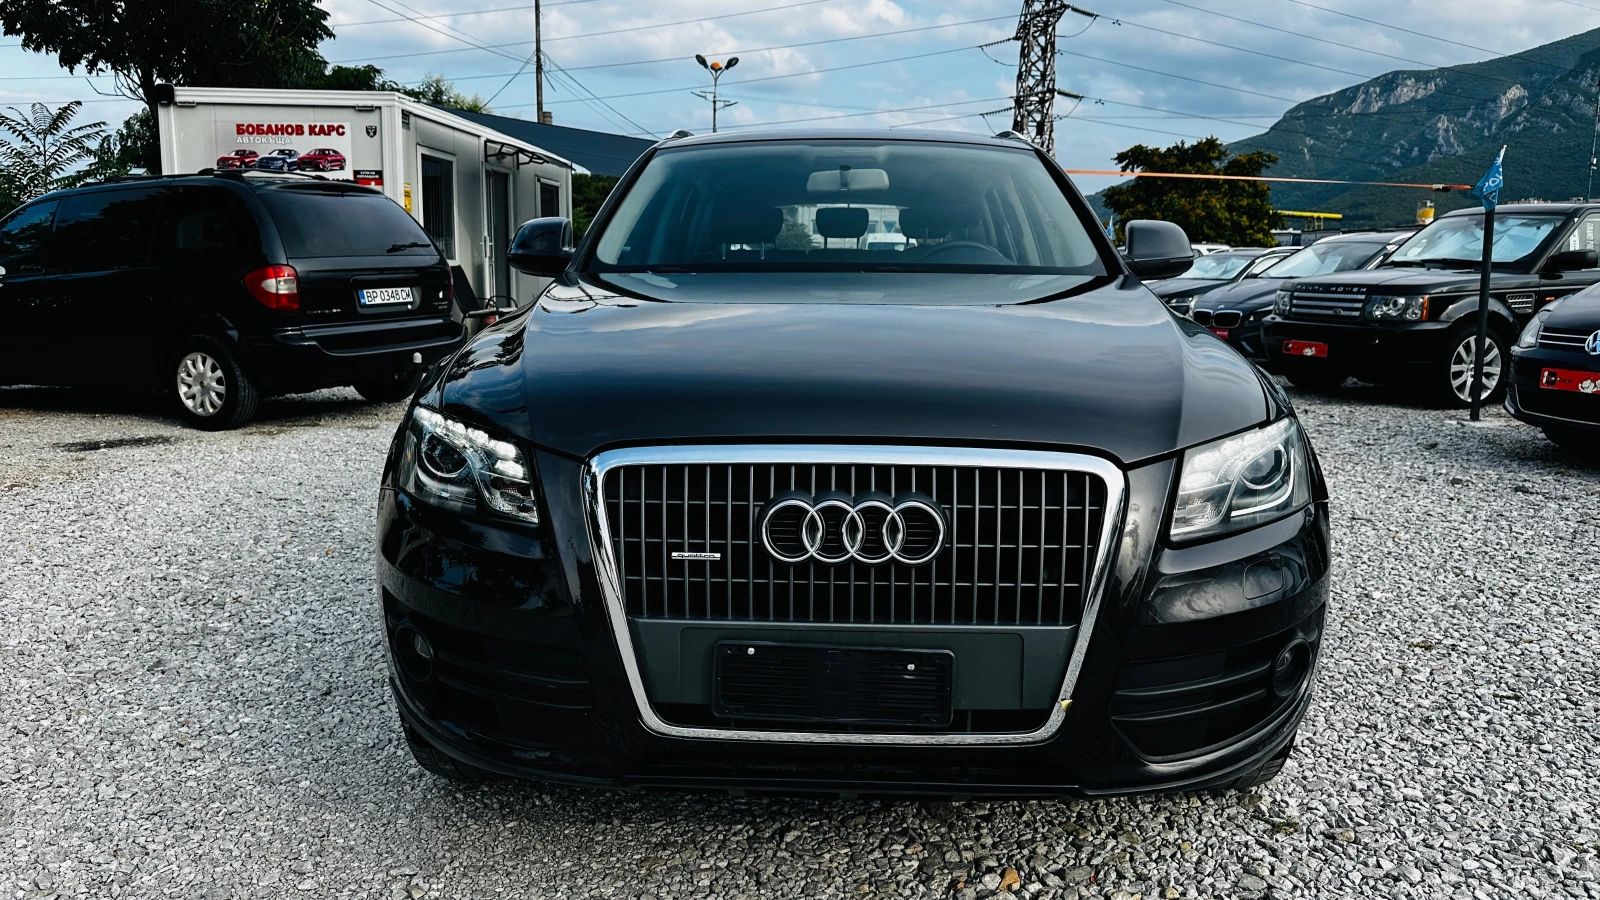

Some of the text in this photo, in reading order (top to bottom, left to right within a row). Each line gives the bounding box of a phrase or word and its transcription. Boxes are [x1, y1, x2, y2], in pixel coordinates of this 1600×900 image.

[235, 123, 346, 136] БОБАНОВ КАРС
[236, 136, 292, 145] АВТОКЪЩА
[380, 289, 401, 301] 0348
